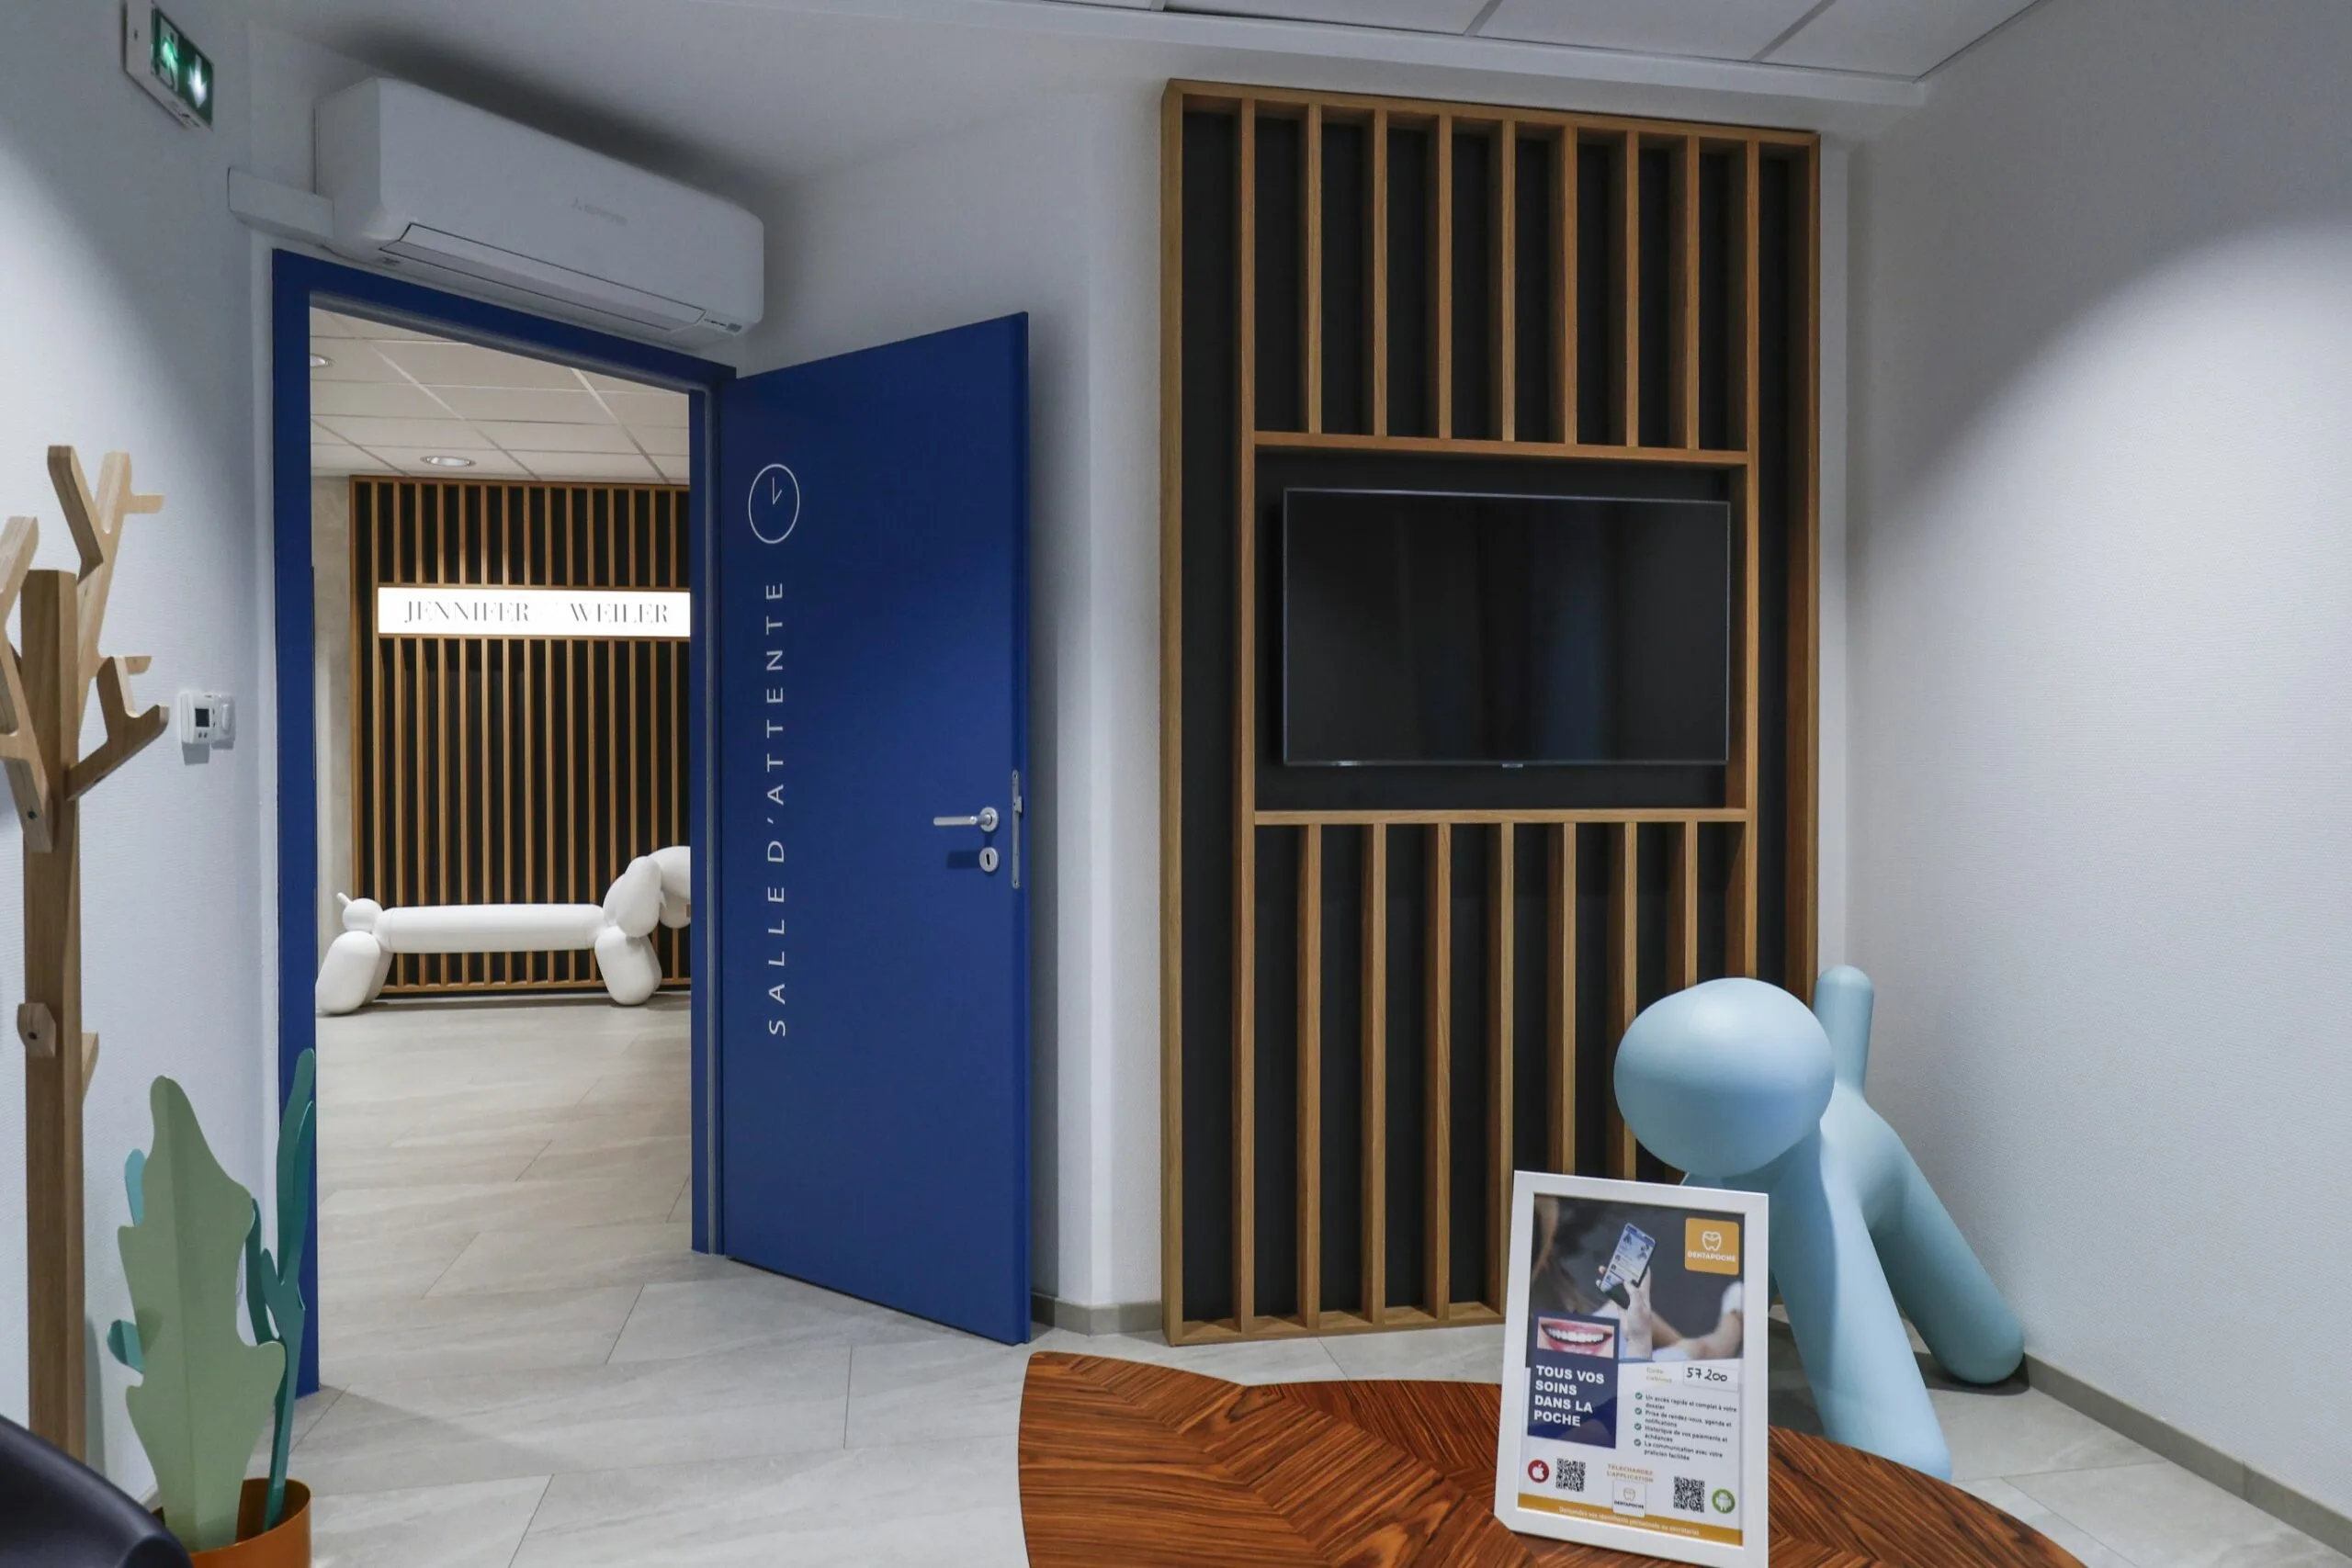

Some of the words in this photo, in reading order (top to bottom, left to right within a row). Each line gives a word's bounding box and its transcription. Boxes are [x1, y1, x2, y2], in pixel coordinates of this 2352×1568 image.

[404, 600, 529, 624] JENNIFER
[570, 603, 668, 624] WEILER
[765, 583, 785, 863] D'ATTENTE
[768, 886, 786, 1037] SALLE
[1535, 1364, 1573, 1381] TOUS
[1577, 1370, 1605, 1385] VOS
[1535, 1380, 1577, 1396] SOINS
[1534, 1394, 1571, 1410] DANS
[1575, 1400, 1593, 1414] LA
[1533, 1409, 1581, 1427] POCHE
